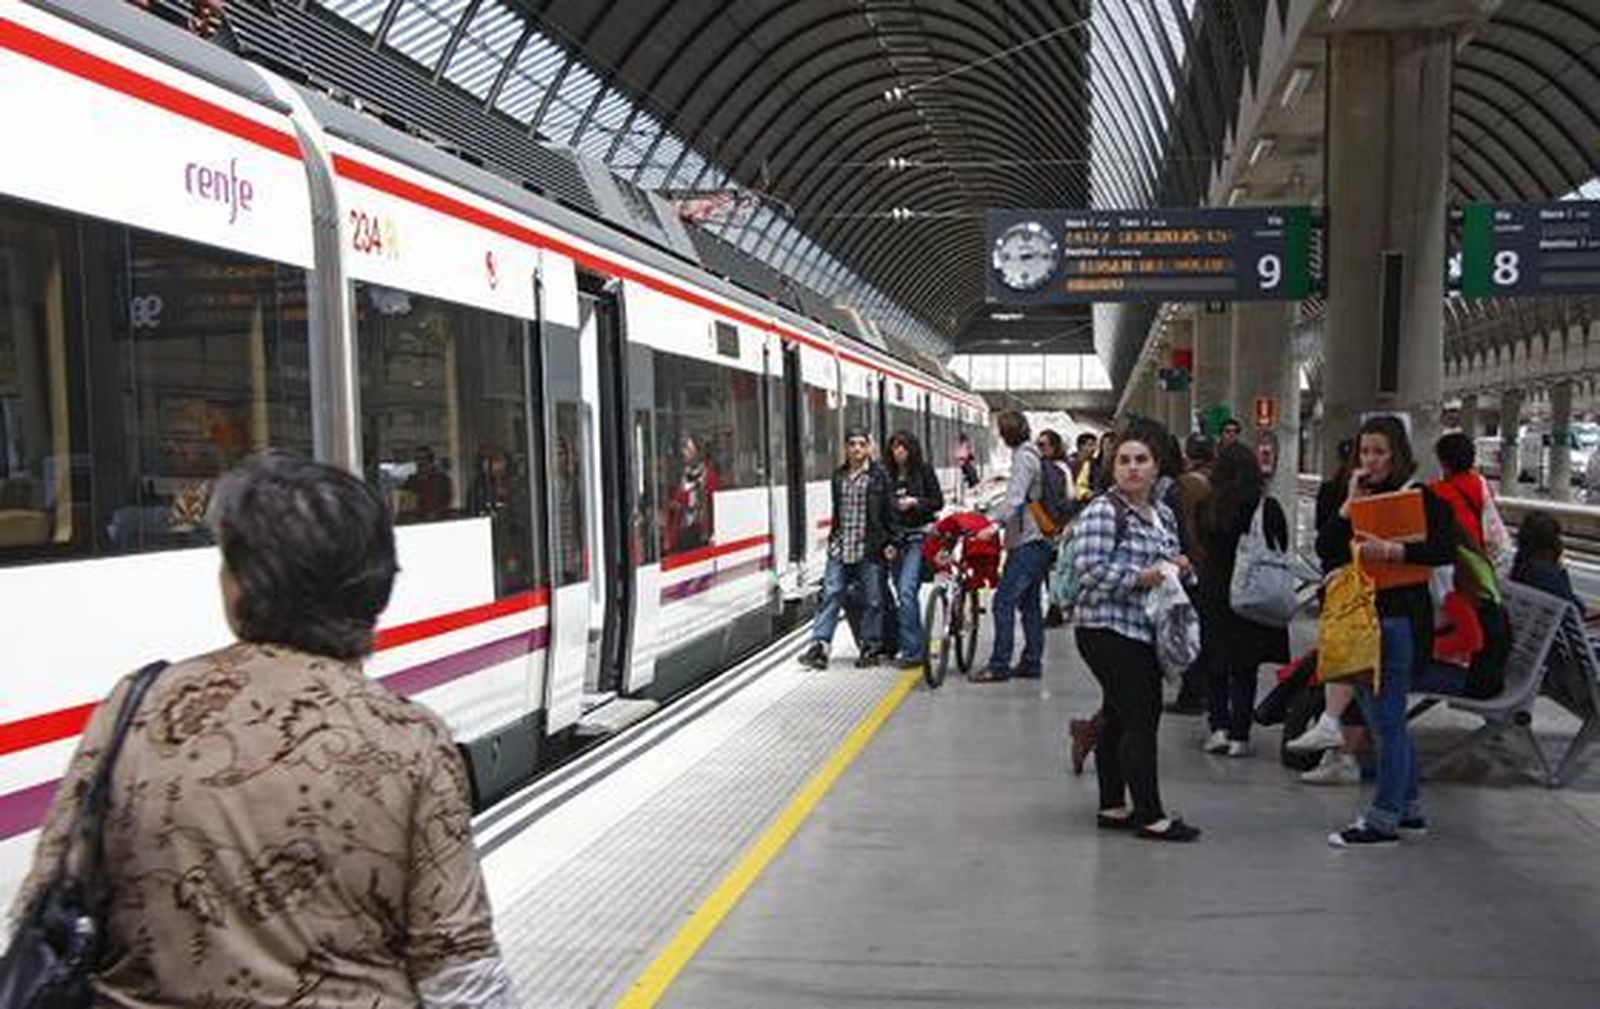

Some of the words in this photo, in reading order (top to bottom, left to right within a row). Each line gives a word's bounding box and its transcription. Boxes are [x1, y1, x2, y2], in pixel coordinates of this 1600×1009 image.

[185, 157, 253, 225] renfe
[349, 209, 383, 255] 234
[1257, 254, 1281, 289] 9
[1492, 250, 1519, 285] 8
